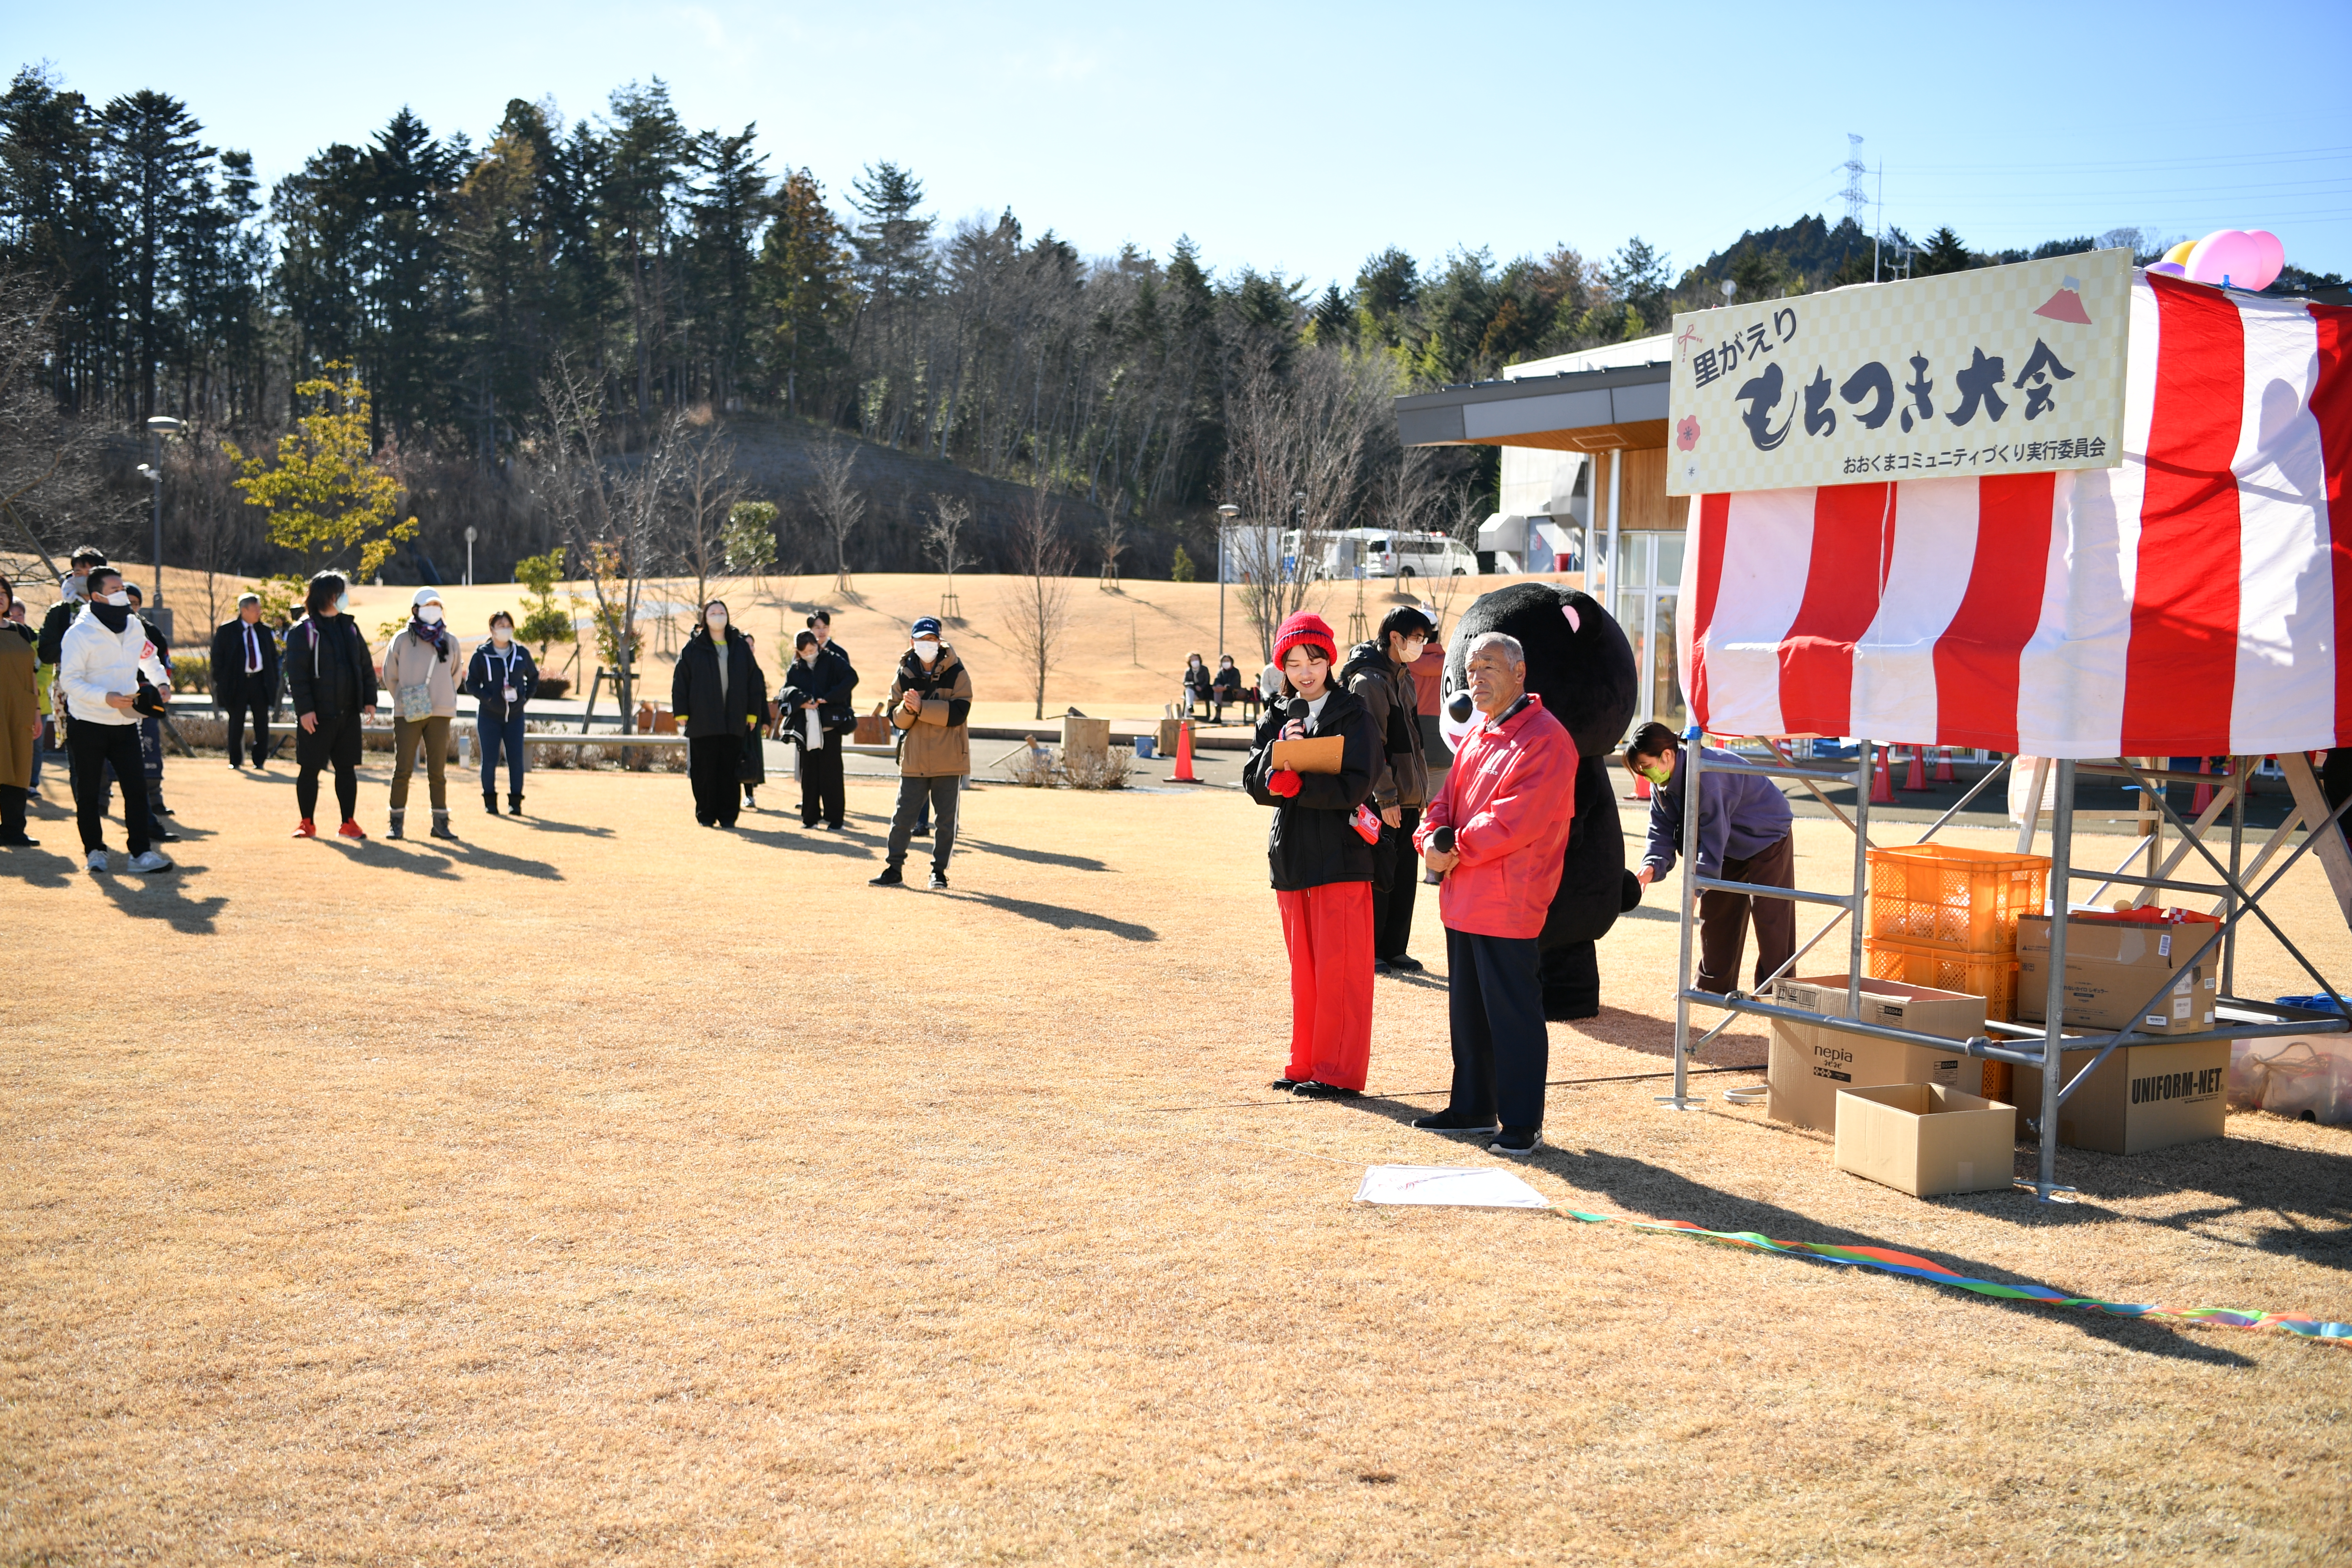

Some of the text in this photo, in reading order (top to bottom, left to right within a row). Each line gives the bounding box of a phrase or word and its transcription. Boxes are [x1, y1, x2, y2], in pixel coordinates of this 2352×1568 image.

[1693, 307, 1797, 389] 里がえり
[1734, 337, 2076, 452] もちつき大会
[1843, 436, 2107, 475] おおくまコミュニティづくり実行委員会
[1814, 1045, 1853, 1063] nepia
[2132, 1067, 2222, 1105] UNIFORM-NET
